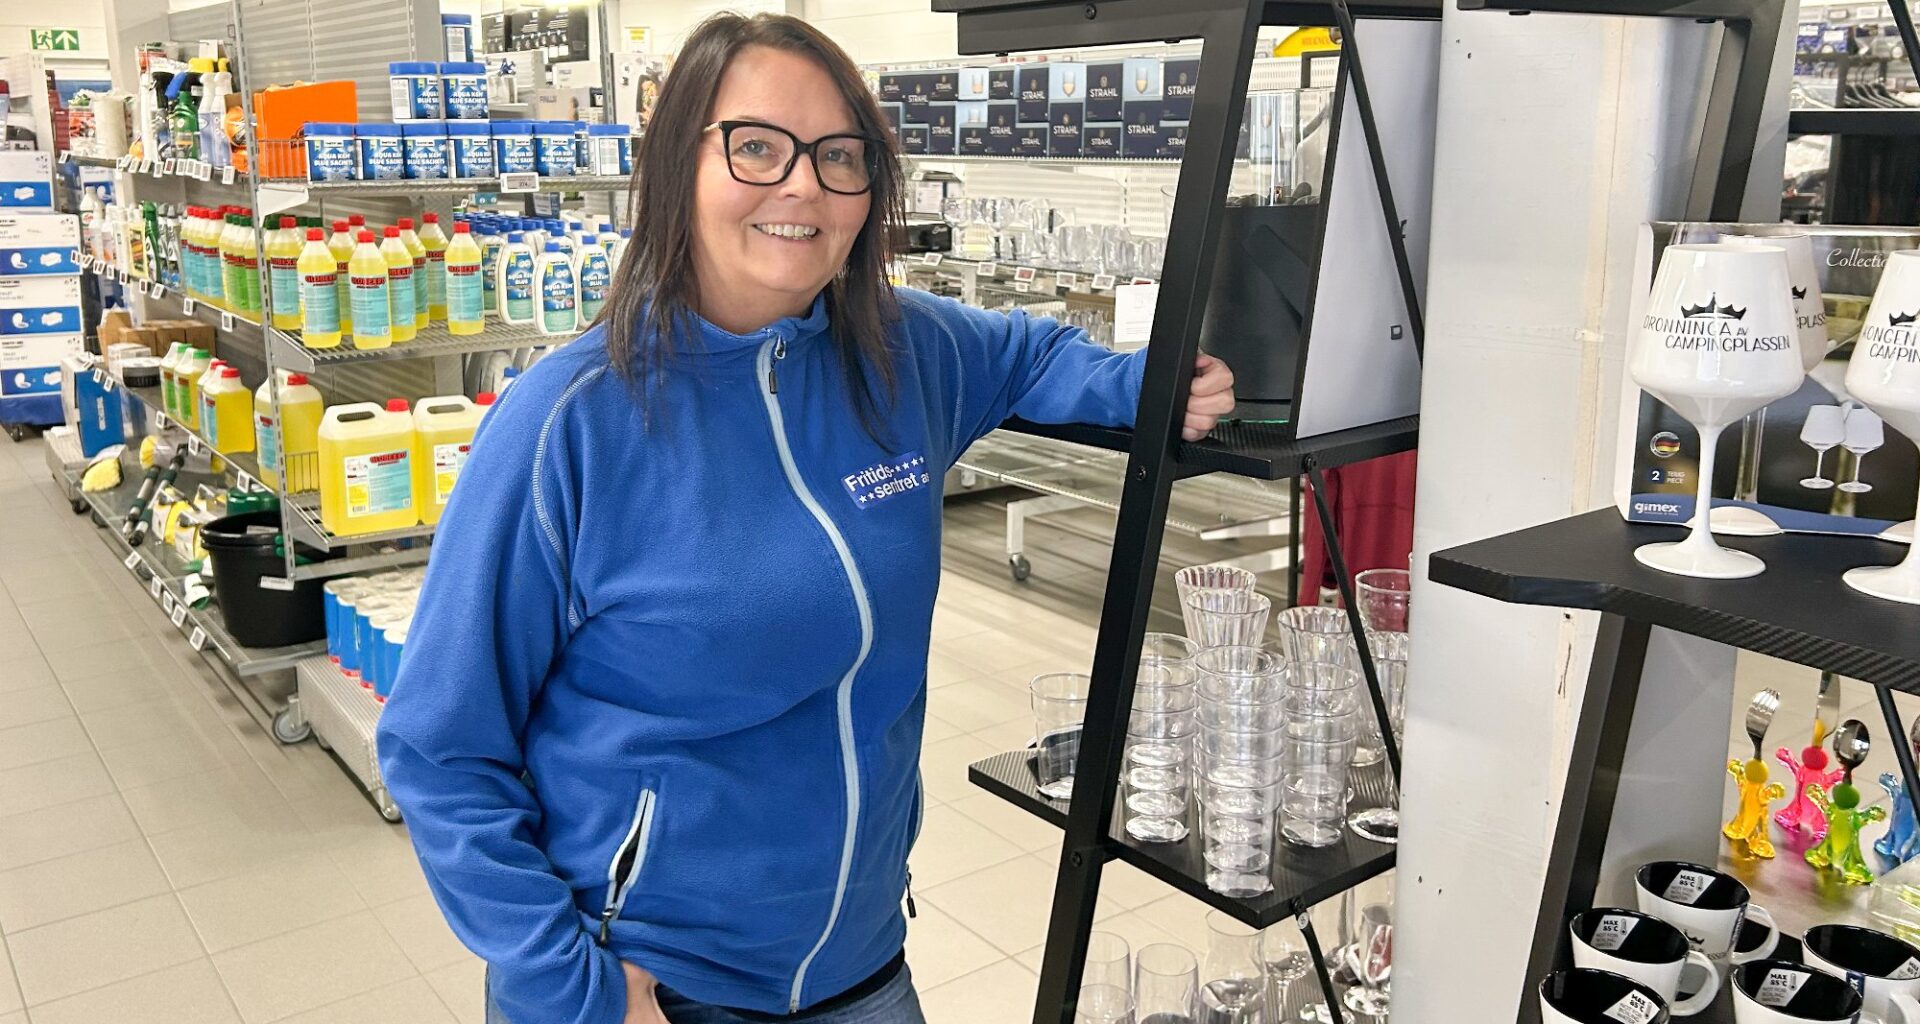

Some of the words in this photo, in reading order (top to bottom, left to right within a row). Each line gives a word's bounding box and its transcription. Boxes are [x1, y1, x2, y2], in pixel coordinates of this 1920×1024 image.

[1022, 90, 1046, 100] STRAHL
[1089, 88, 1119, 97] STRAHL
[990, 126, 1012, 135] STRAHL
[1053, 125, 1078, 134] STRAHL
[1128, 124, 1156, 134] STRAHL
[1091, 138, 1113, 146] STRAHL
[1167, 137, 1186, 146] STRA
[1642, 315, 1732, 336] DRONNINGA
[1736, 327, 1748, 336] AV
[1665, 334, 1791, 352] CAMPINGPLASSEN
[1651, 470, 1660, 481] 2
[874, 472, 920, 499] sentret
[1634, 502, 1679, 514] gimex
